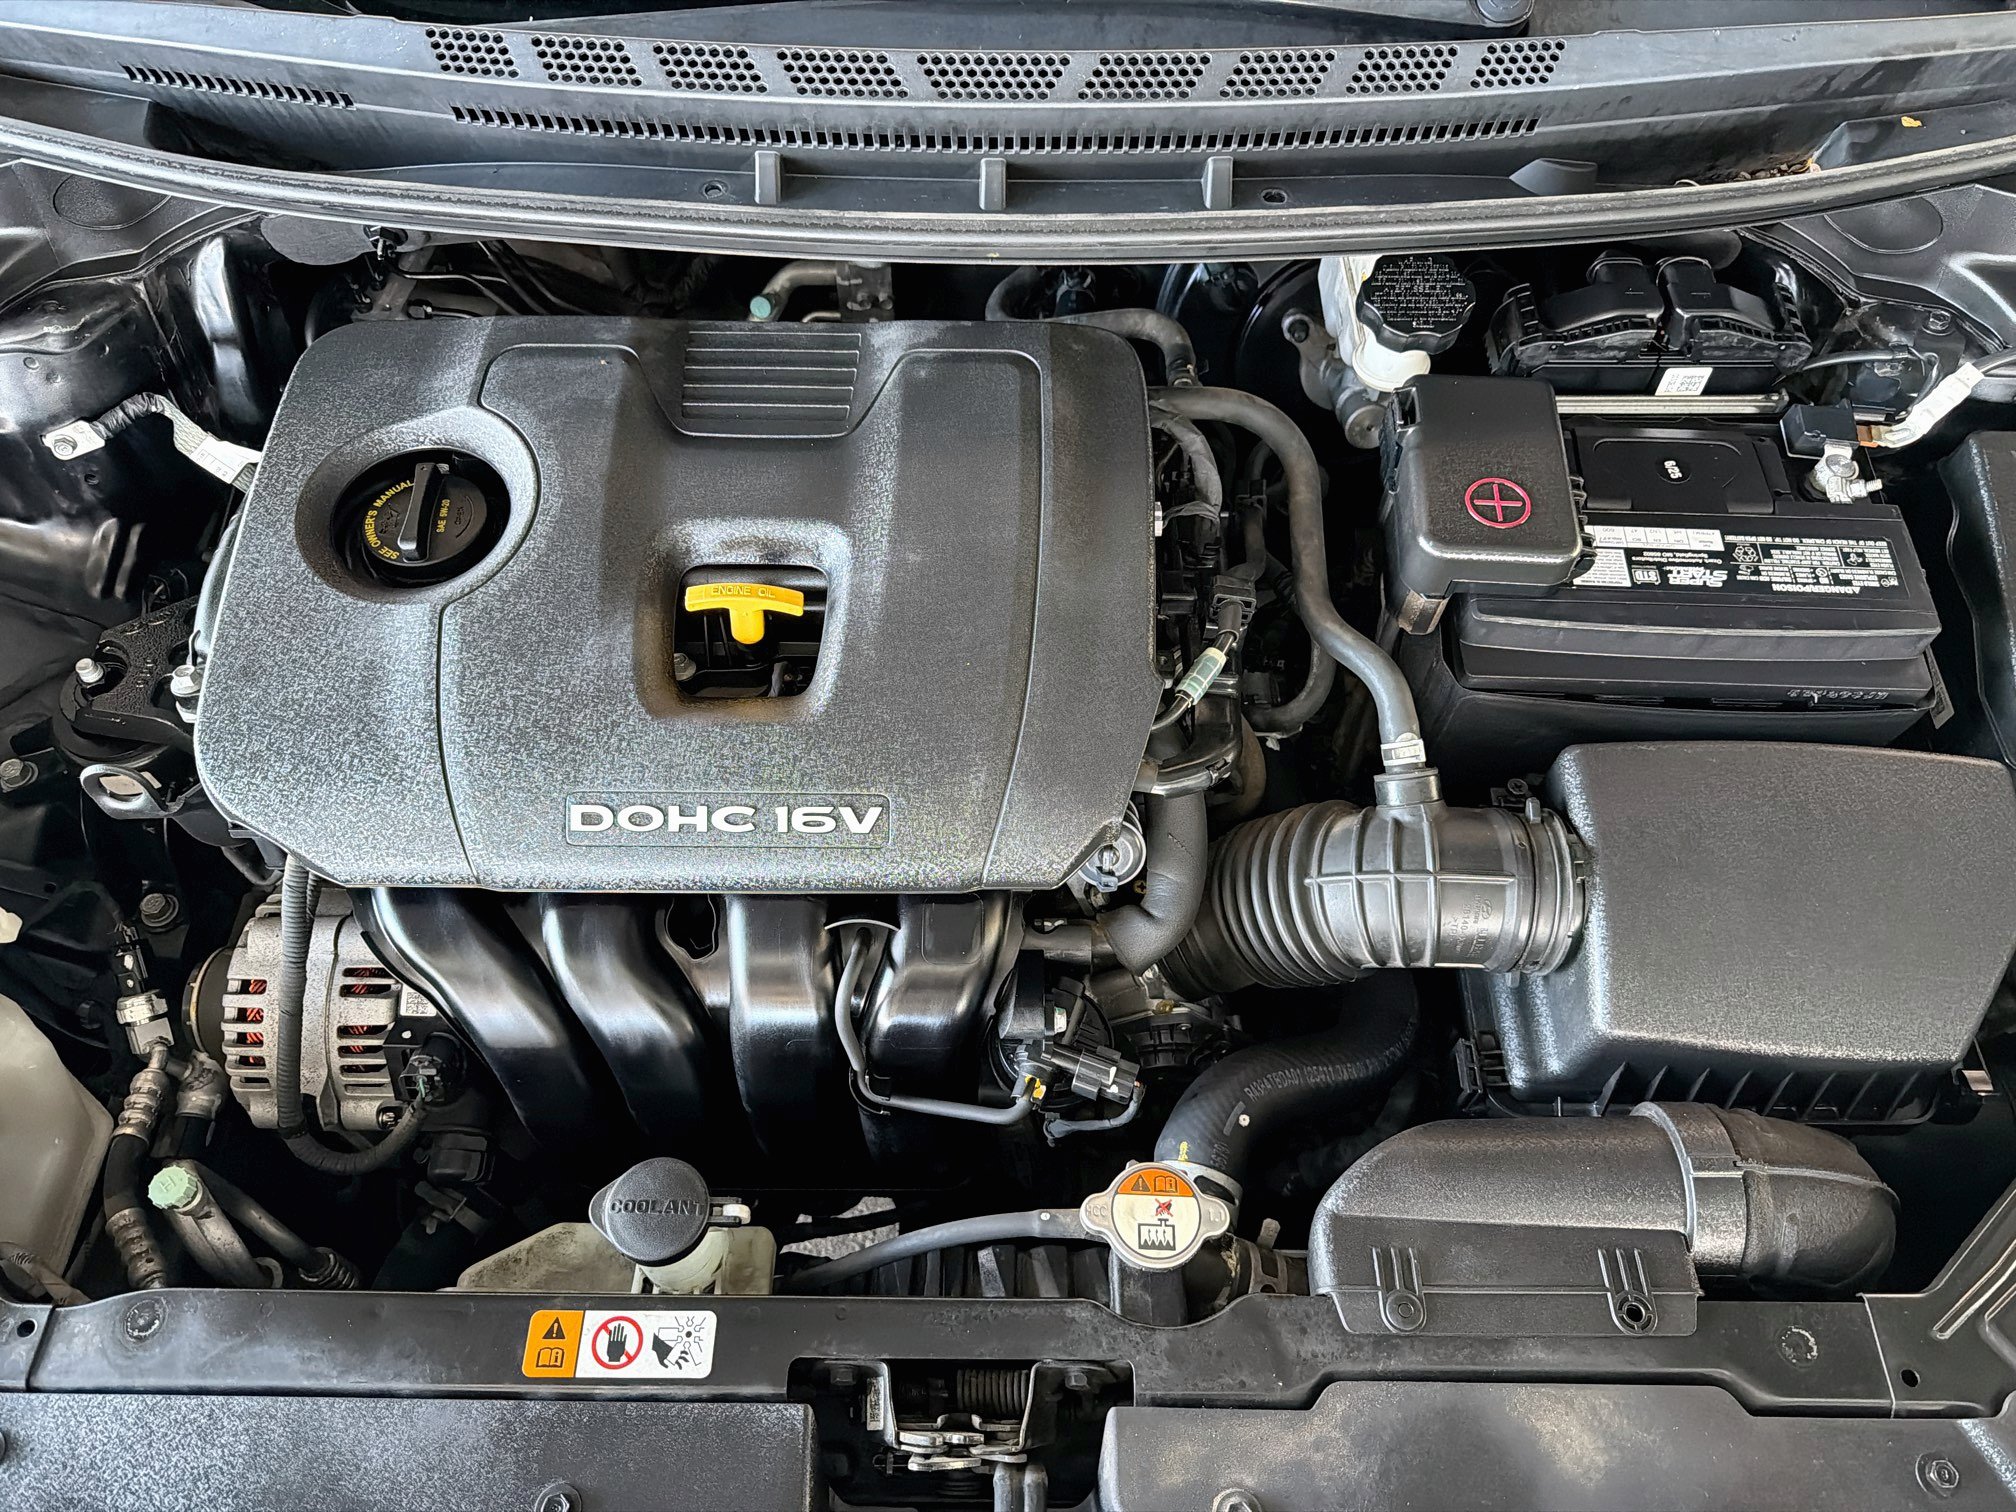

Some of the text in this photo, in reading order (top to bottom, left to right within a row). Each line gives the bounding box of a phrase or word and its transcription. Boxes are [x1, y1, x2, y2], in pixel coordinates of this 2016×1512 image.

[363, 480, 415, 560] SEE OWNER'S MANUAL
[436, 499, 451, 533] SAE 5W-20
[1635, 570, 1657, 580] STD
[1668, 570, 1727, 580] START
[1668, 578, 1723, 587] SUPER
[1772, 584, 1853, 593] DANGER/POISON
[711, 585, 776, 598] ENGINE OIL
[570, 805, 883, 834] DOHC 16V
[609, 1199, 705, 1217] COOLANT
